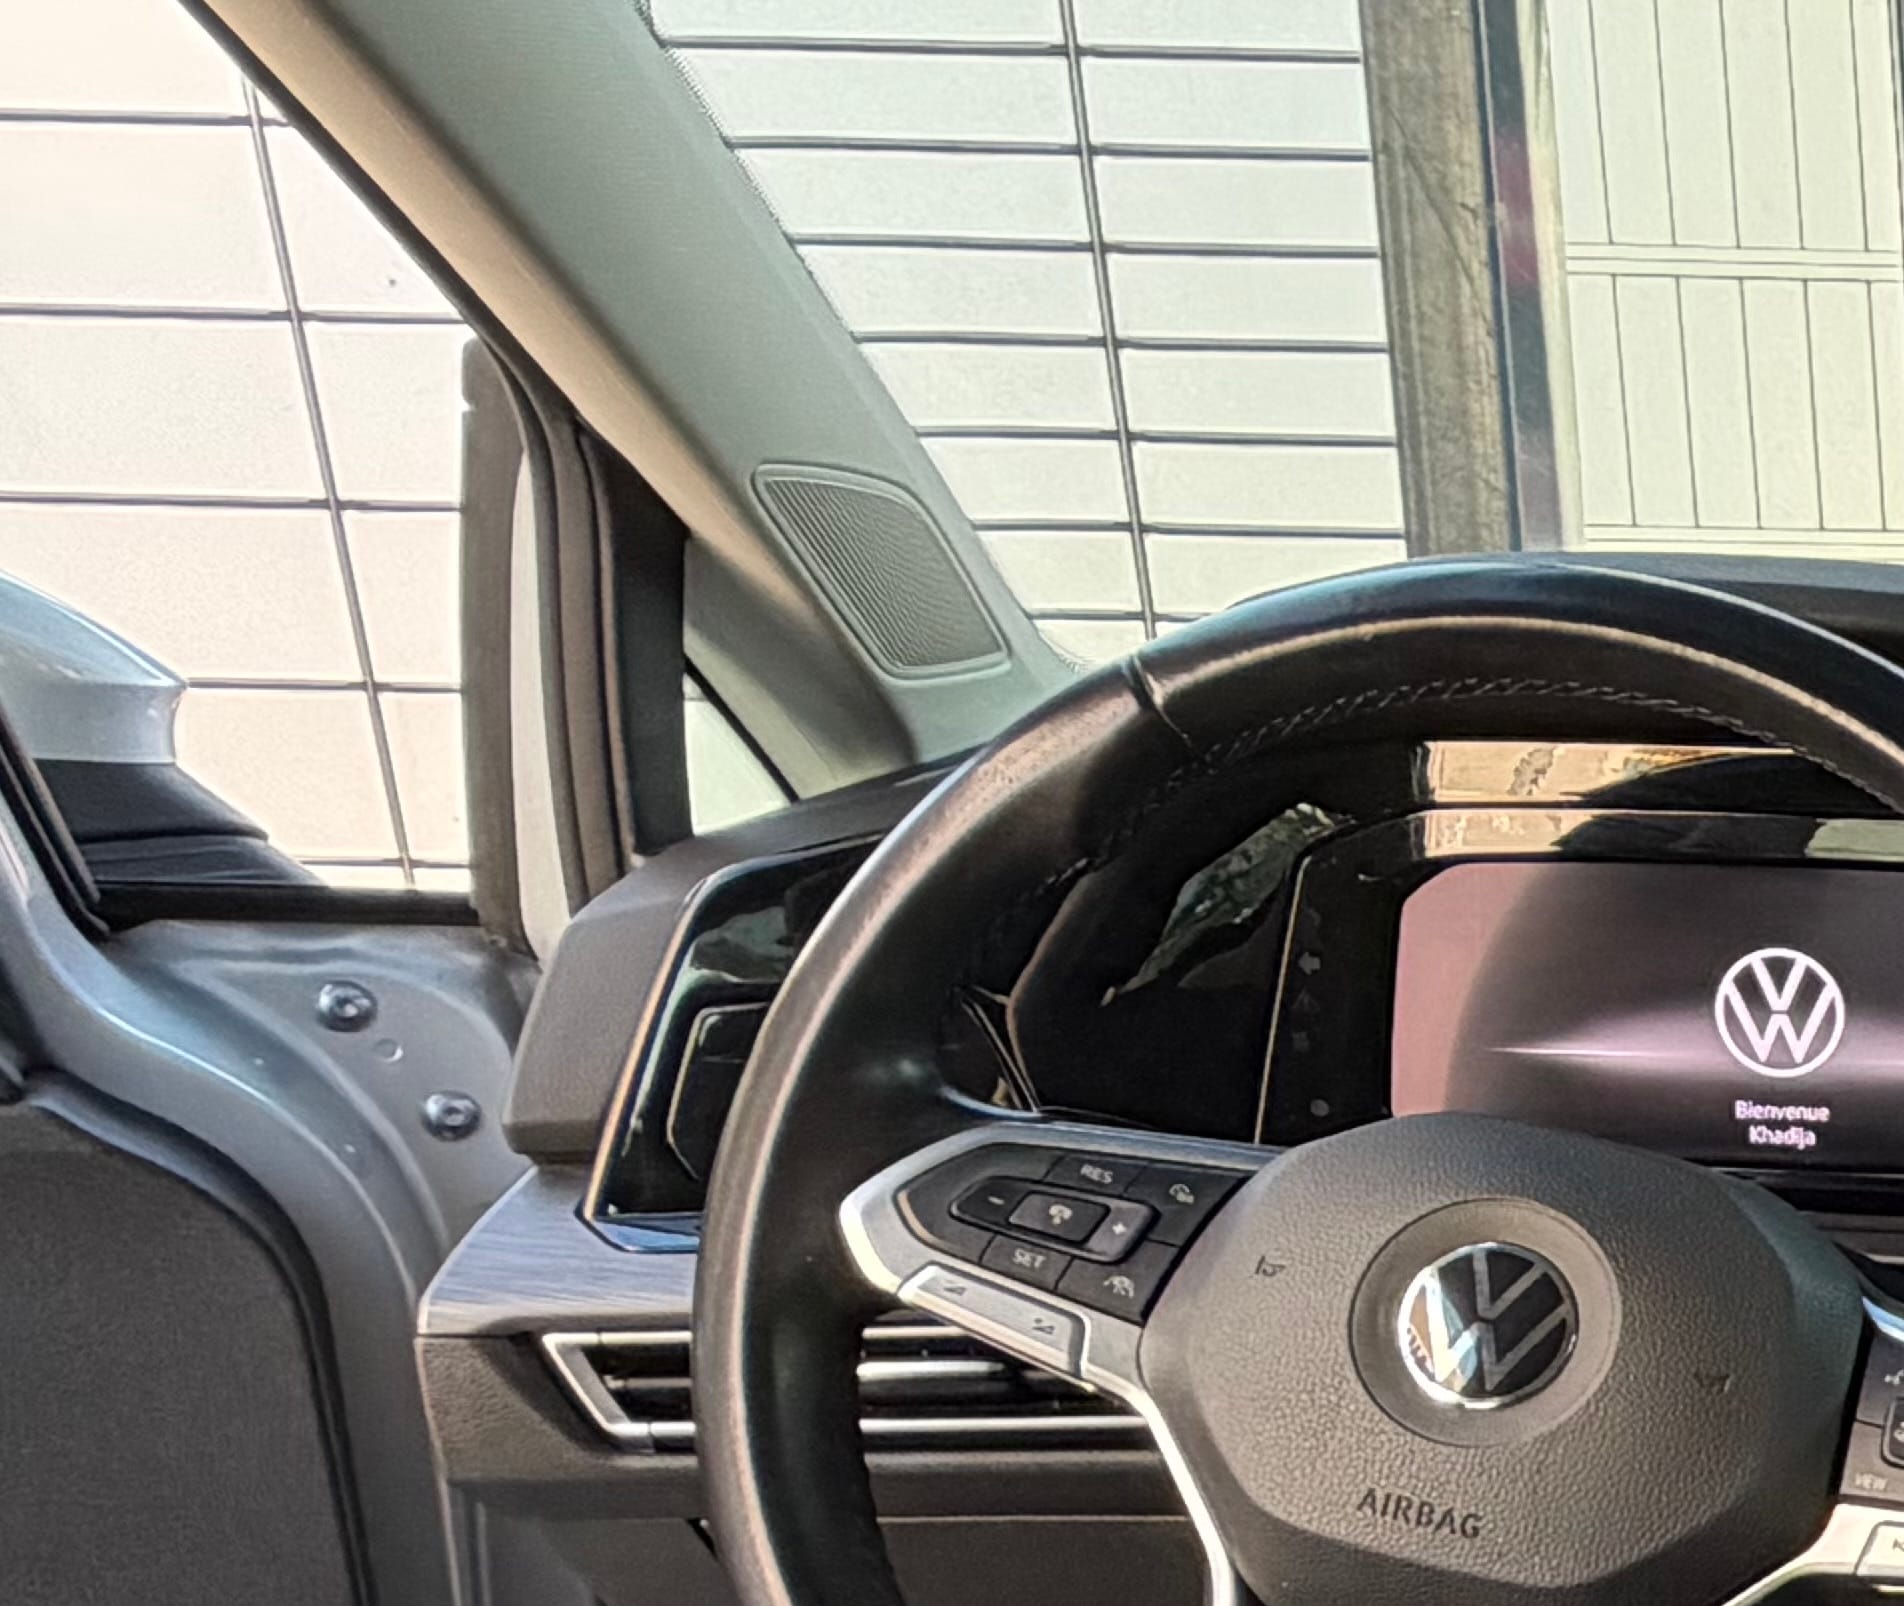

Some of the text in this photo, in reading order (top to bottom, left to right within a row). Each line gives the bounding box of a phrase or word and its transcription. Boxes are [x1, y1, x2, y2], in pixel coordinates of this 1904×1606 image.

[1734, 1099, 1831, 1122] Bienvenue
[1748, 1124, 1817, 1151] Khadija
[1080, 1163, 1114, 1185] RES
[1011, 1249, 1047, 1269] SET
[1854, 1472, 1890, 1492] VIEW
[1357, 1487, 1484, 1540] AIRBAG
